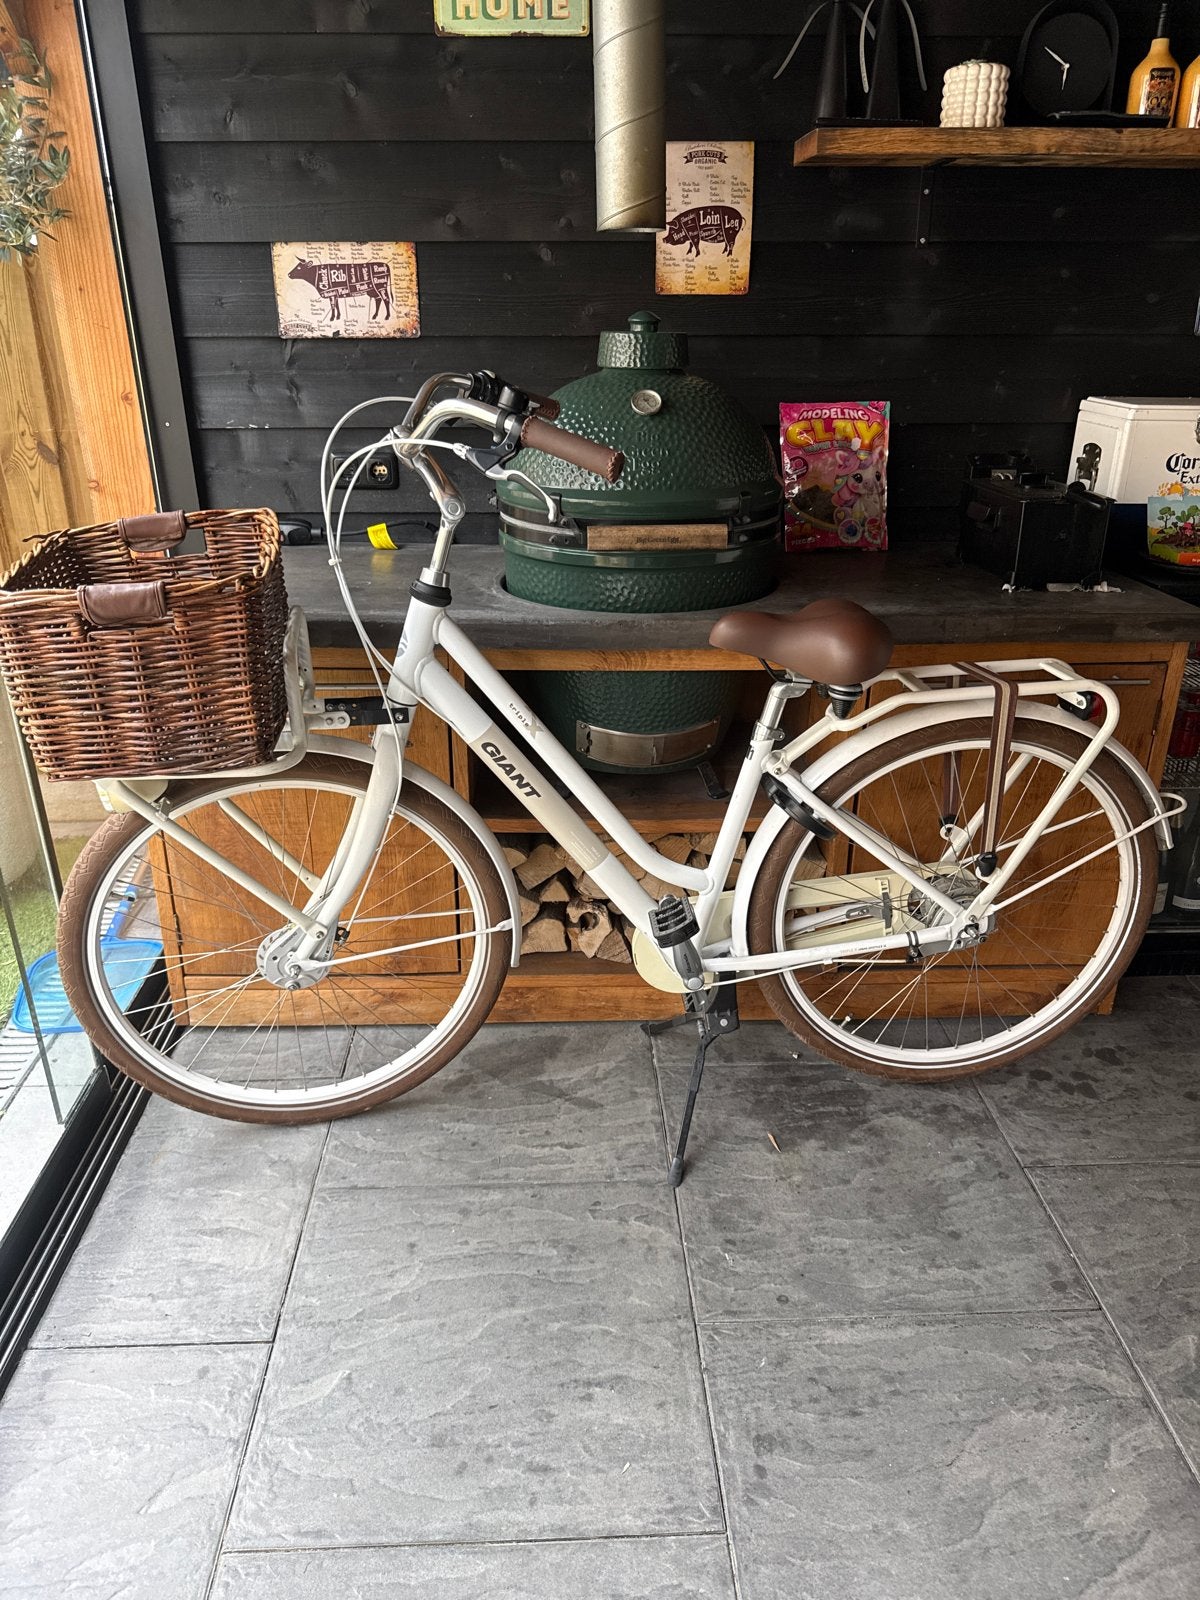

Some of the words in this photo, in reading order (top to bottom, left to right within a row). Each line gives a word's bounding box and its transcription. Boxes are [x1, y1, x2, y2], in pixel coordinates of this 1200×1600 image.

[452, 0, 571, 20] HOME
[706, 150, 721, 158] CUTS
[699, 210, 720, 226] Loin
[724, 215, 739, 231] Leg
[318, 268, 329, 290] Chuck
[330, 269, 347, 282] Rib
[799, 407, 870, 420] MODELING
[785, 419, 884, 450] CLAY
[481, 741, 542, 798] GIANT
